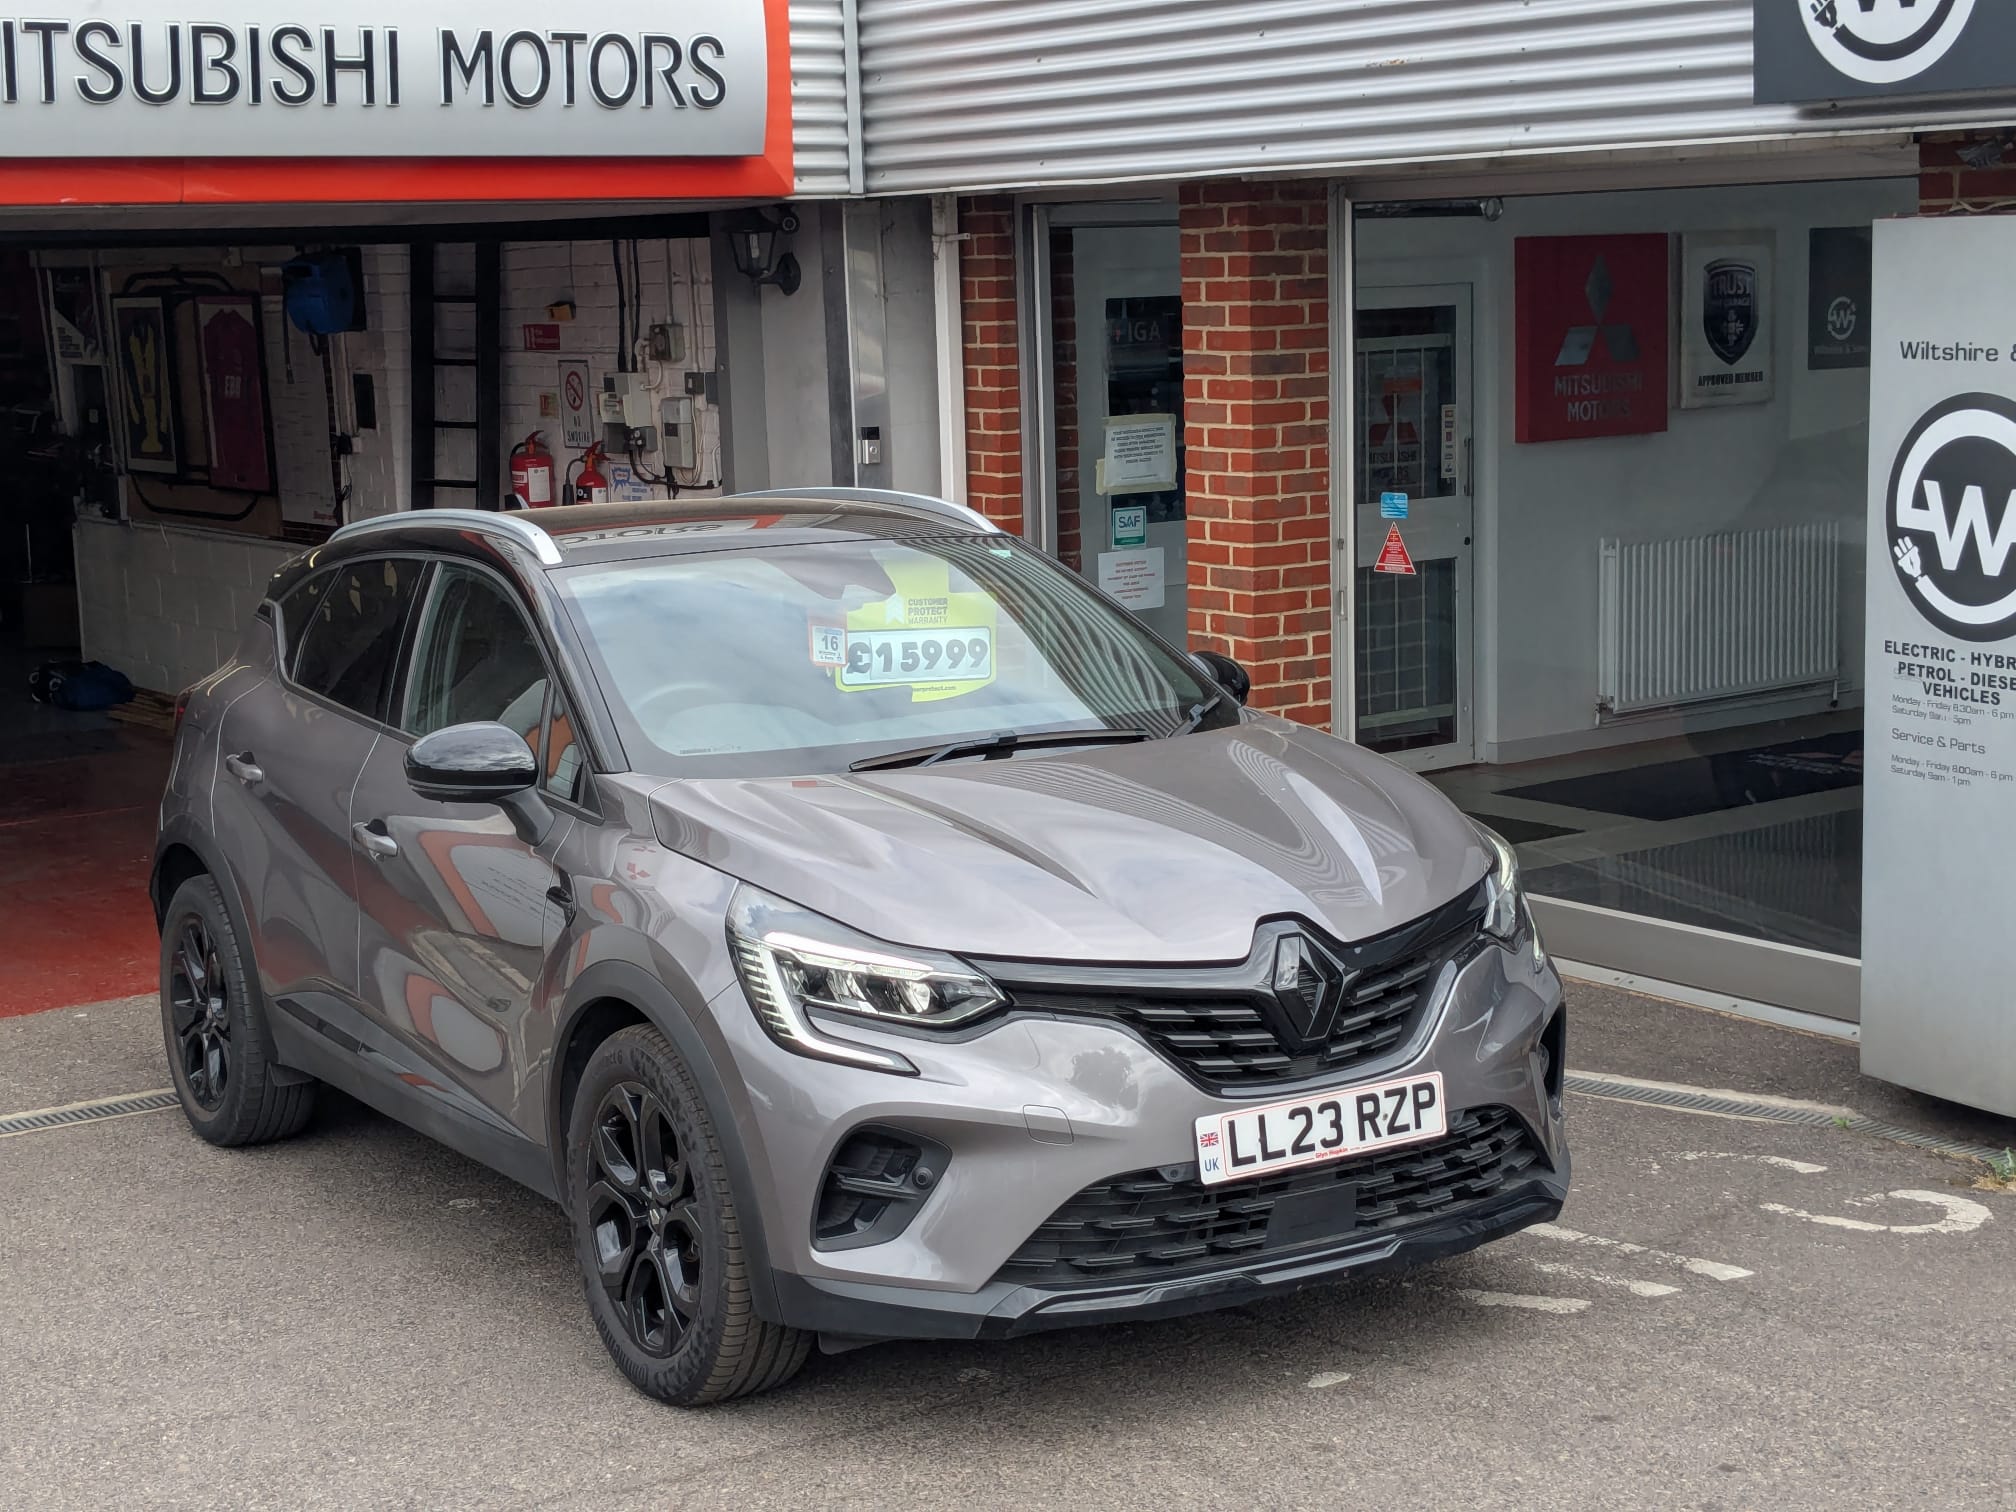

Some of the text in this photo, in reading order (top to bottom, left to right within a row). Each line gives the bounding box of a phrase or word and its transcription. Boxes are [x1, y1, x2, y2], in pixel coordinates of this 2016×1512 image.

[0, 18, 727, 109] ITSUBISHI MOTORS
[1710, 274, 1751, 296] TRUST
[1899, 340, 1999, 362] Wiltshire
[1698, 371, 1763, 387] APPROVED MEMBER
[1118, 515, 1141, 529] SAF
[908, 598, 948, 607] CUSTOMER
[908, 606, 948, 616] PROTECT
[908, 615, 948, 625] WARRANTY
[821, 635, 840, 655] 16
[1884, 640, 1957, 663] ELECTRIC
[847, 638, 989, 674] £15999
[1898, 661, 1957, 683] PETROL
[1892, 694, 1922, 707] Monday
[1927, 700, 1951, 713] Friday
[1922, 681, 2002, 706] VEHICLES
[1892, 704, 1928, 720] Saturday
[1891, 727, 1987, 755] Service & Parts
[1890, 764, 1927, 780] Saturday
[1891, 753, 1920, 768] Monday
[1926, 759, 1950, 773] Friday
[1228, 1080, 1437, 1168] LL23 RZP
[1204, 1156, 1220, 1173] UK
